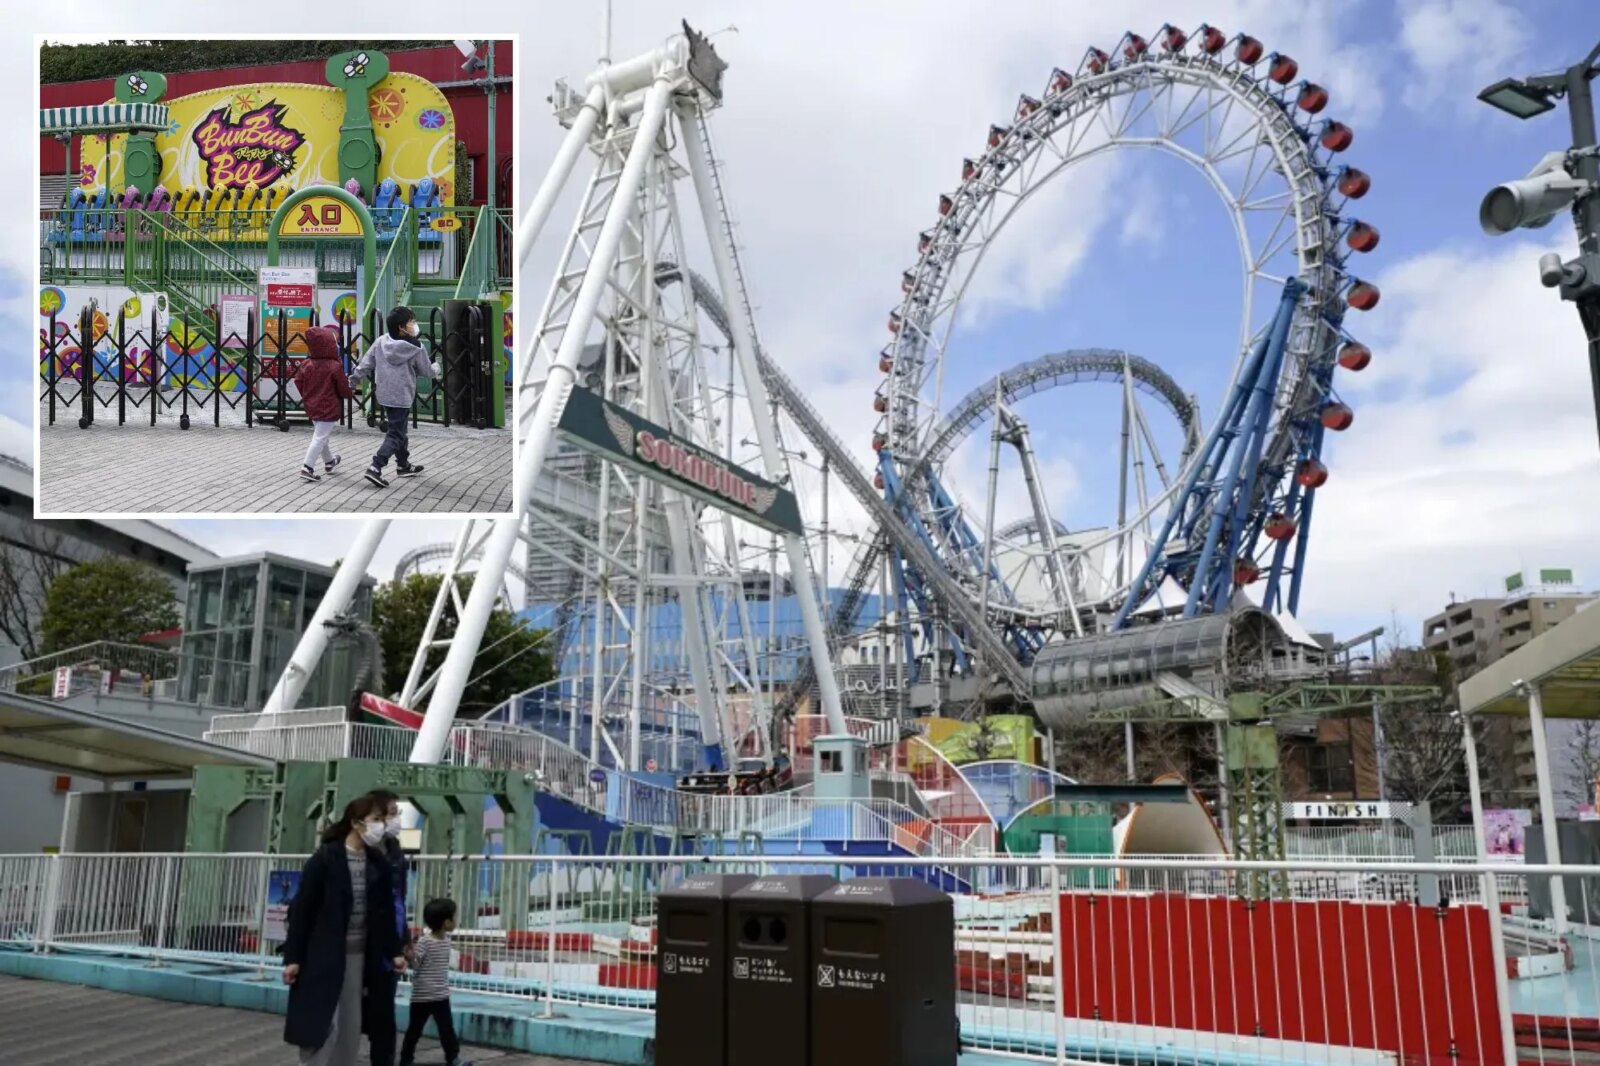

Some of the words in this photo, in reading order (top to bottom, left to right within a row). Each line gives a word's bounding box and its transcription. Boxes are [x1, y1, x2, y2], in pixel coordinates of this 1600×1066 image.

[213, 151, 279, 185] Bee
[297, 204, 341, 226] 入口
[1305, 804, 1378, 817] FINISH
